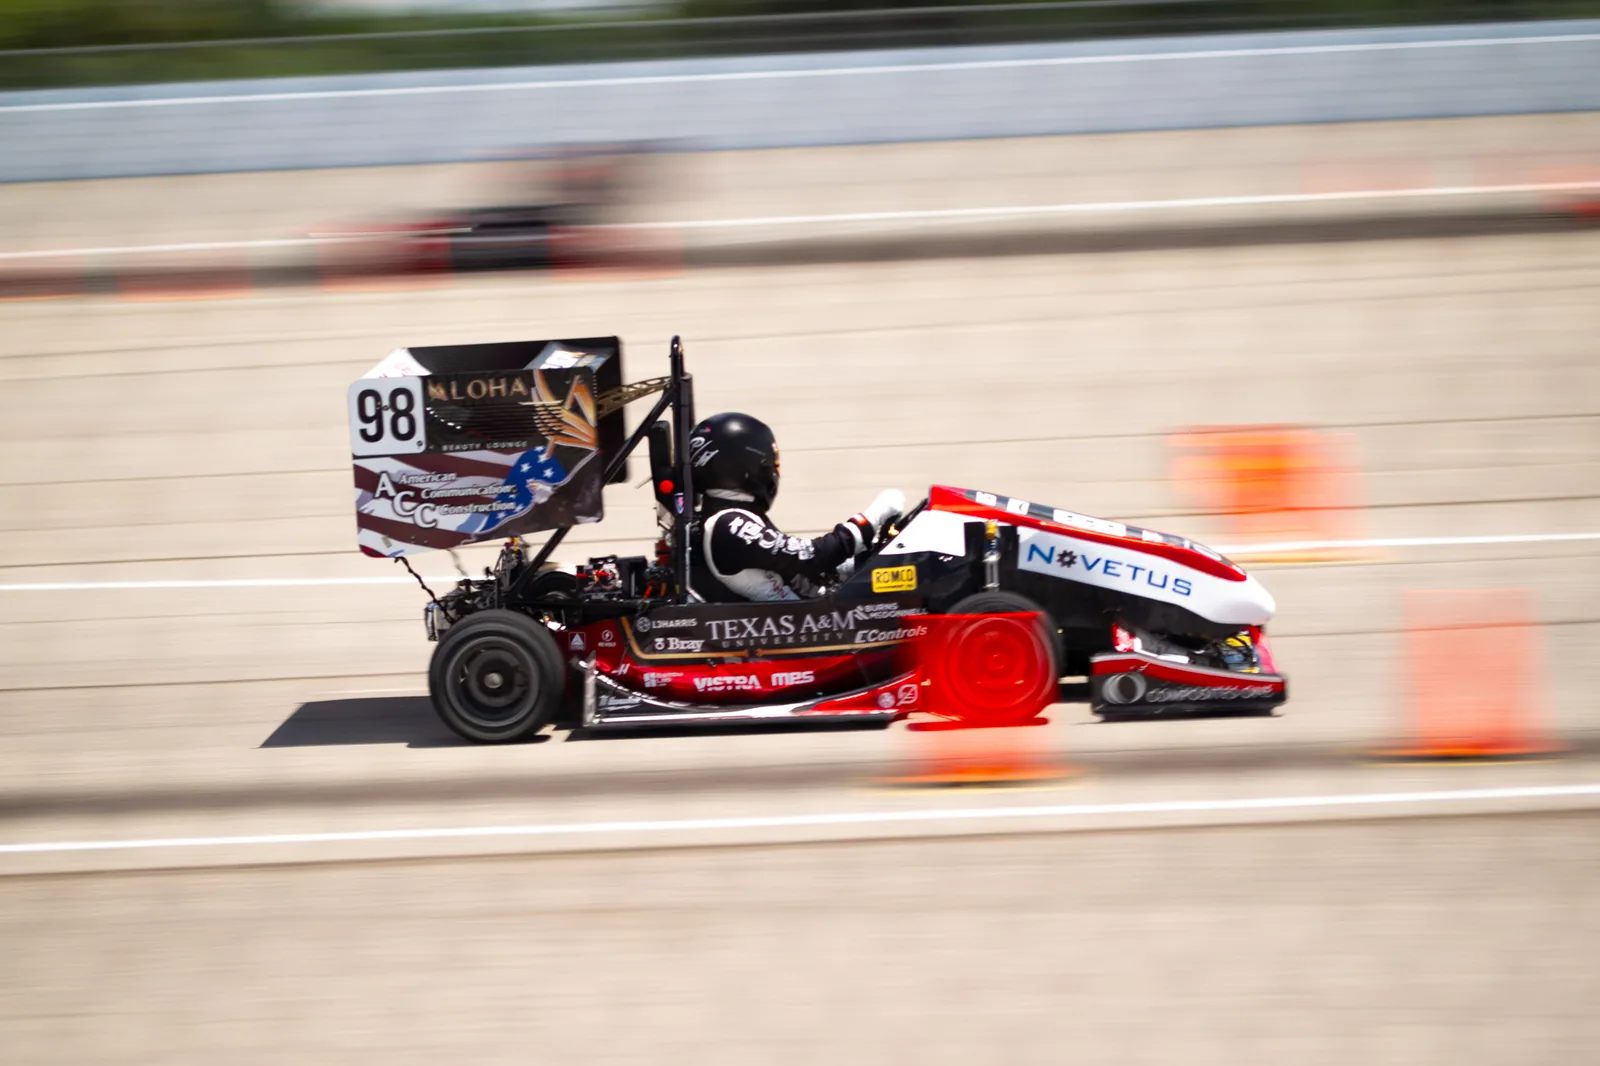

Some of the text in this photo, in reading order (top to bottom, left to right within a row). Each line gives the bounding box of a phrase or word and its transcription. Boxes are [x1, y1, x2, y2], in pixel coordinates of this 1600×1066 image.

[357, 387, 417, 443] 98
[442, 441, 528, 451] BEAUTY LOUNGE
[399, 471, 457, 484] American
[439, 501, 516, 515] Construction
[875, 569, 913, 584] ROMCO
[1026, 543, 1193, 597] NOVETUS
[652, 618, 698, 629] L3HARRIS
[705, 610, 856, 640] TEXAS A&M
[721, 632, 844, 648] UNIVERSITY
[854, 625, 928, 643] EControls
[667, 637, 705, 652] Bray
[693, 674, 762, 692] VISTRA
